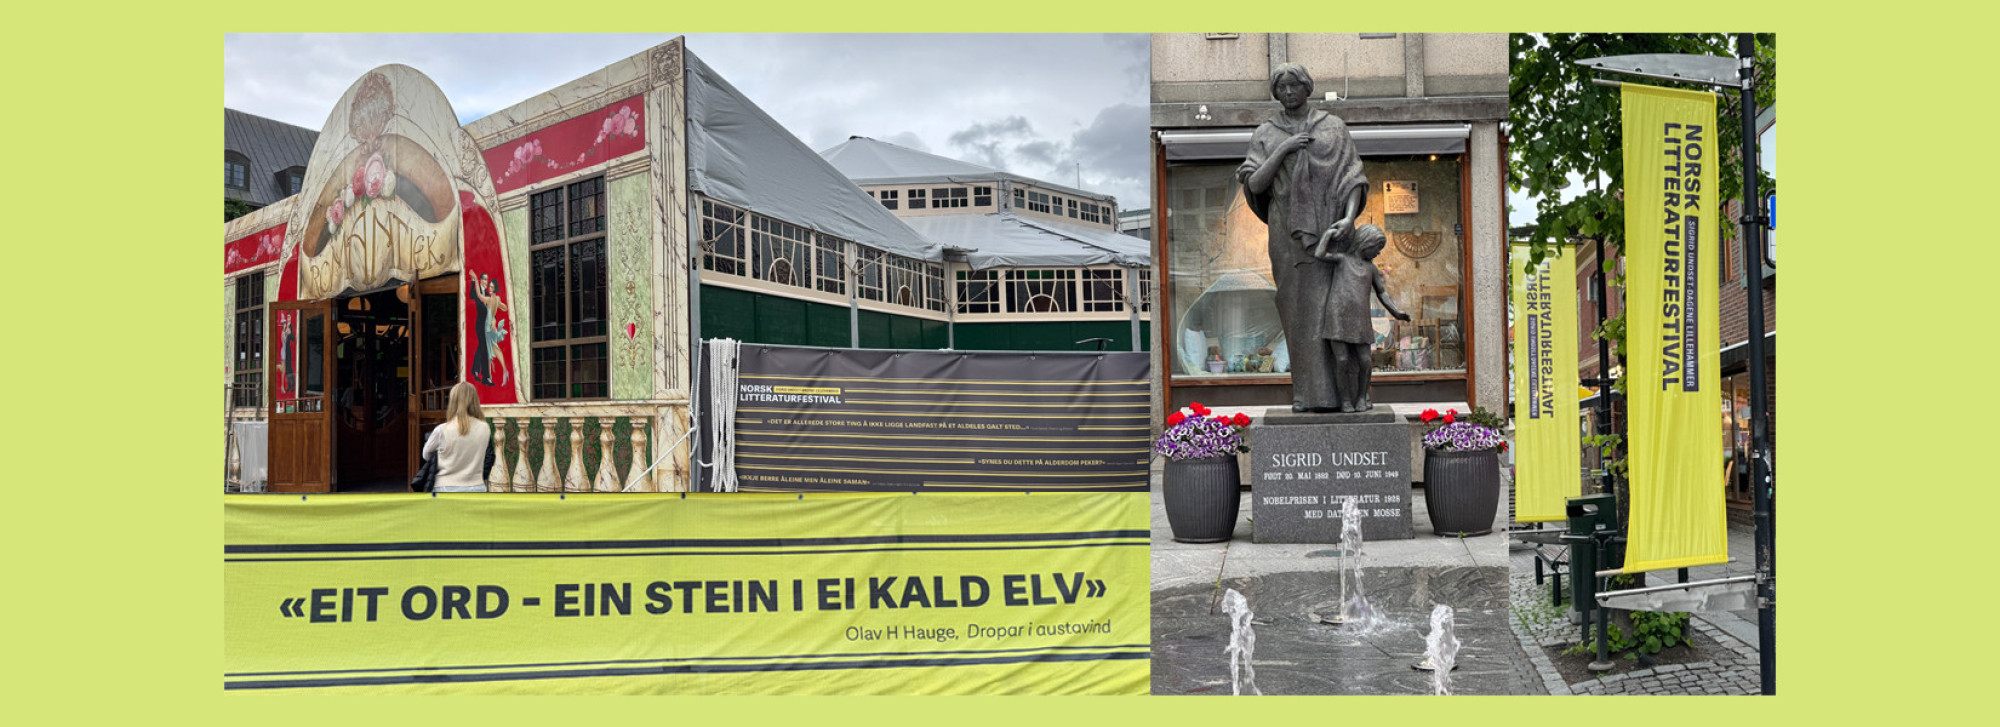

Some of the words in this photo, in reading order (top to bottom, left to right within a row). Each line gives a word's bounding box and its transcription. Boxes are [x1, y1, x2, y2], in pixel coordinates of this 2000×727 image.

[1684, 124, 1702, 211] NORSK
[1688, 220, 1696, 250] SIGRID
[1662, 122, 1681, 391] LITTERATURFESTIVAL
[1686, 325, 1696, 387] LILLEHAMMER
[740, 385, 773, 393] NORSK
[740, 394, 841, 404] LITTERATURFESTIVAL
[938, 421, 947, 429] PÅ
[1034, 457, 1043, 465] PÅ
[1272, 453, 1322, 468] SIGRID
[1331, 452, 1388, 466] UNDSET
[1297, 472, 1311, 480] MAI
[1365, 470, 1382, 478] JUNI
[1263, 496, 1319, 505] NOBELPRISEN
[1304, 510, 1323, 519] MED
[1373, 509, 1400, 517] MOSSE
[280, 587, 389, 623] «EIT
[400, 585, 509, 621] ORD
[554, 583, 632, 617] EIN
[645, 579, 778, 615] STEIN
[793, 579, 802, 611] I
[817, 578, 854, 611] EI
[869, 575, 990, 609] KALD
[1003, 572, 1107, 606] ELV»
[845, 626, 882, 641] Olav
[887, 626, 898, 640] H
[903, 624, 960, 642] Hauge,
[967, 622, 1024, 641] Dropar
[1027, 622, 1033, 637] i
[1036, 618, 1111, 637] austavind
